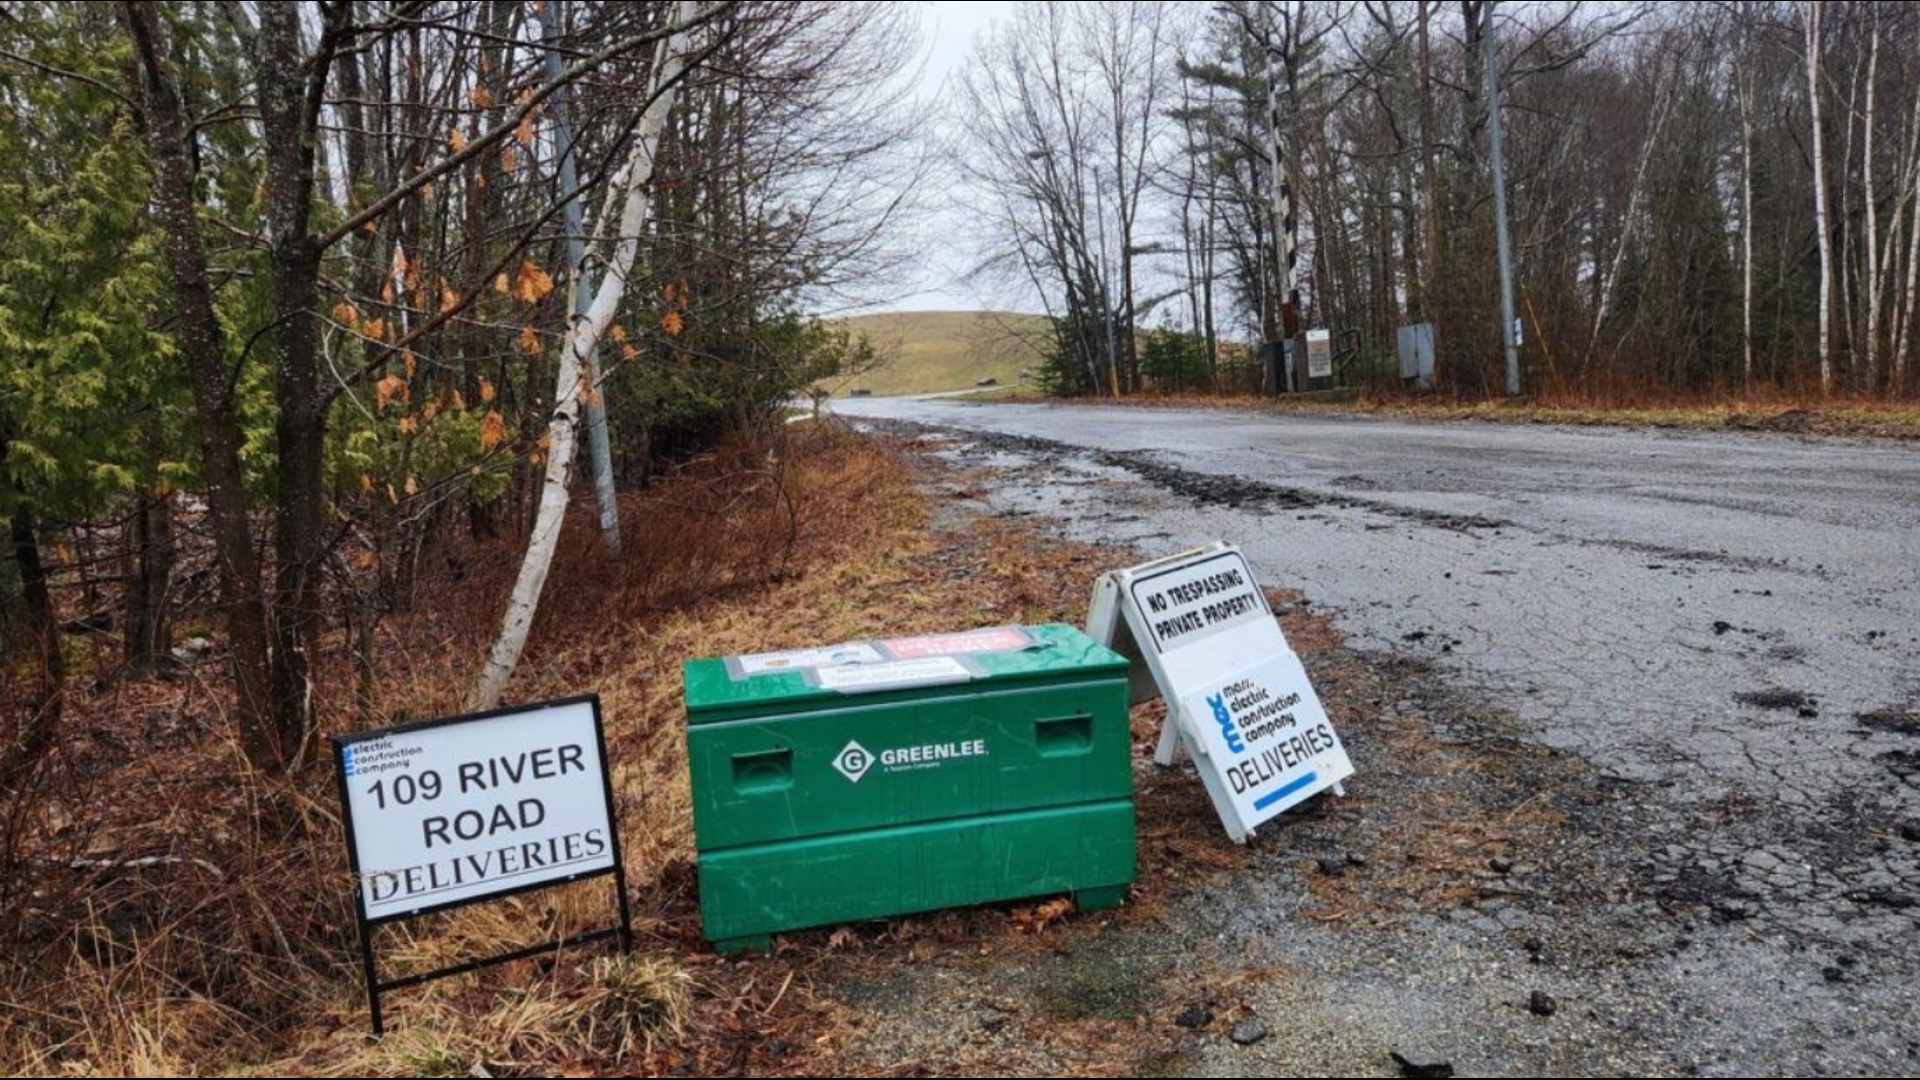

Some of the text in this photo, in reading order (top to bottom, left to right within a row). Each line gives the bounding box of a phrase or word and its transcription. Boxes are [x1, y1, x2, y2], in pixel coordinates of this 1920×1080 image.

[1147, 568, 1244, 613] NO TRESPASSING
[1155, 592, 1258, 640] PRIVATE PROPERTY
[1230, 688, 1270, 712] electric
[1238, 692, 1301, 728] construction
[1245, 713, 1297, 742] company
[354, 740, 393, 754] electric
[354, 746, 423, 764] construction
[844, 752, 862, 770] G
[880, 739, 985, 765] GREENLEE
[1226, 723, 1334, 794] DELIVERIES
[355, 759, 410, 774] company
[367, 743, 585, 810] 109 RIVER
[422, 798, 545, 848] ROAD
[370, 828, 605, 901] DELIVERIES
